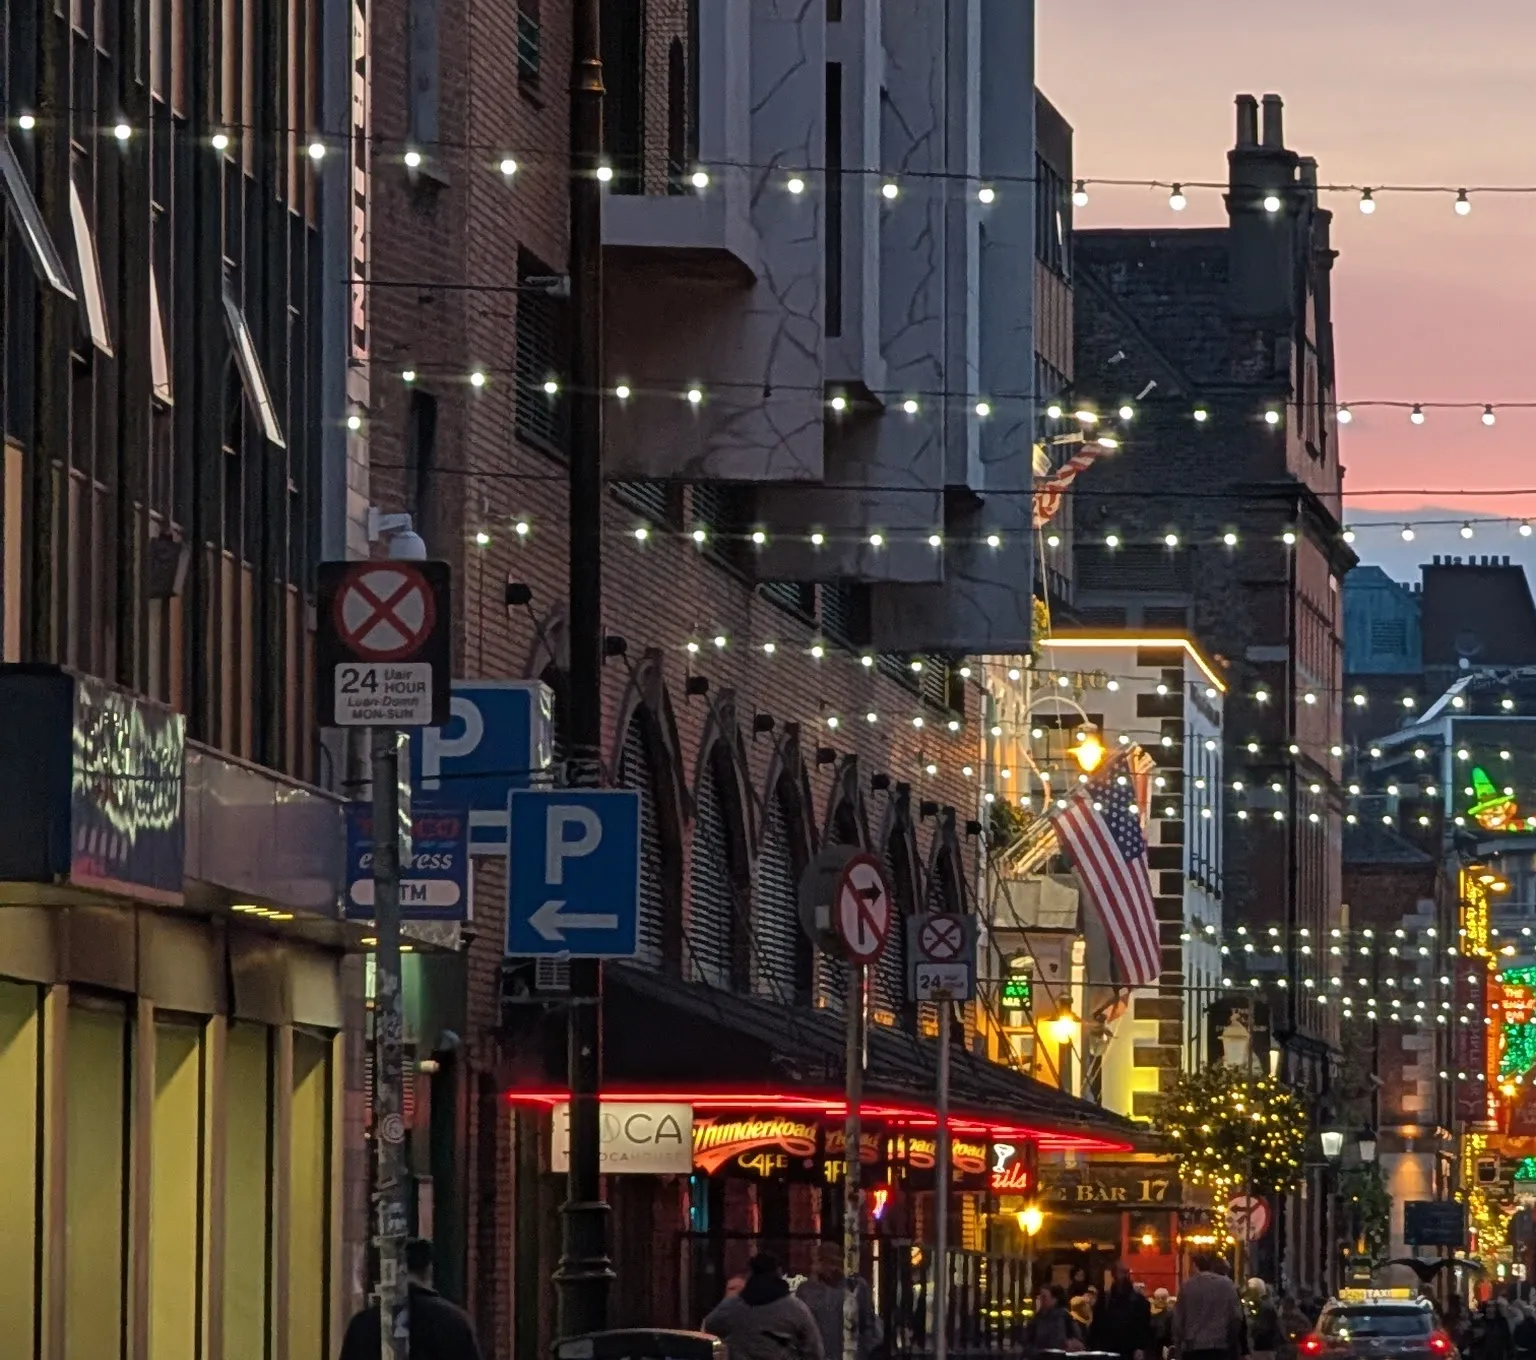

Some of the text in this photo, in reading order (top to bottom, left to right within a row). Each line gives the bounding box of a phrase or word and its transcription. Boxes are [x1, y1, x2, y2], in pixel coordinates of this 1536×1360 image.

[341, 668, 379, 694] 24
[384, 682, 426, 693] HOUR
[351, 709, 414, 720] MON-SUN
[420, 696, 485, 791] P
[545, 804, 603, 885] P
[359, 851, 452, 870] eress
[919, 974, 941, 990] 24
[737, 1152, 789, 1178] CAFE
[1076, 1184, 1128, 1202] BAR
[1136, 1179, 1170, 1203] 17
